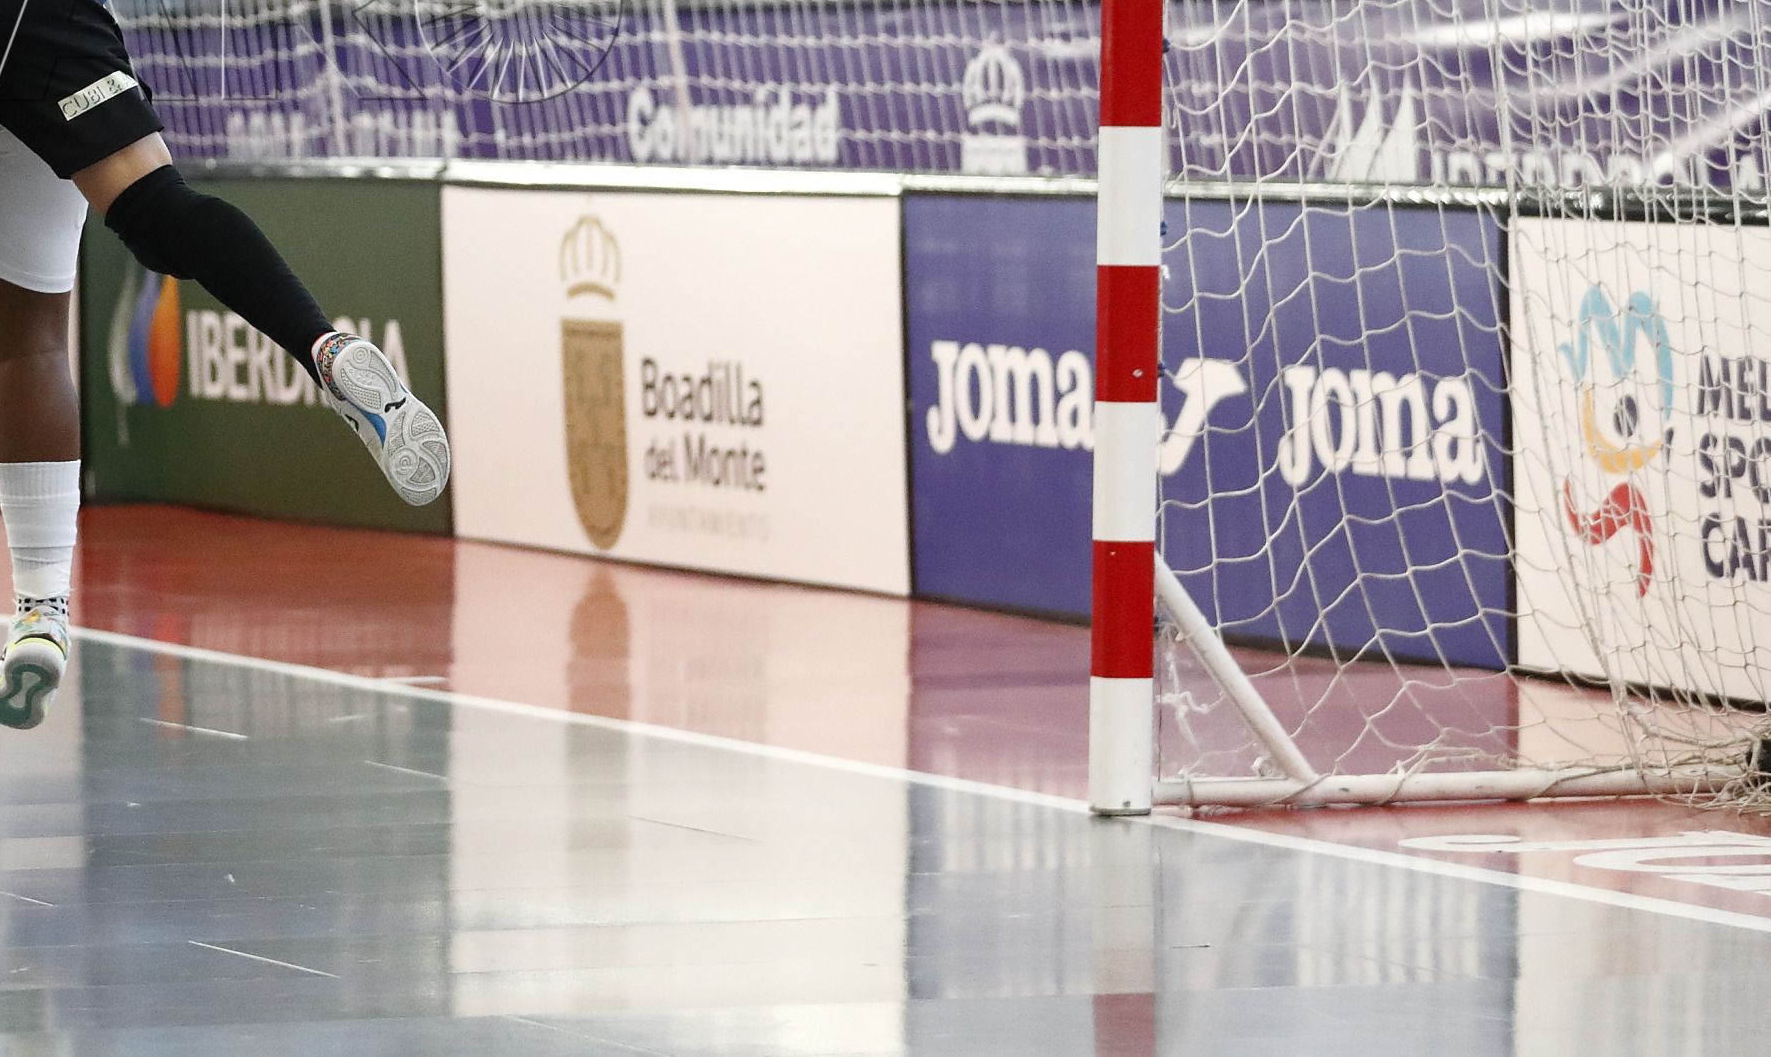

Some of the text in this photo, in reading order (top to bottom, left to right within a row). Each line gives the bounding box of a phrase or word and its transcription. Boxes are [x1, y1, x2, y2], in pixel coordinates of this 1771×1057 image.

[62, 85, 106, 117] CUBI
[628, 86, 841, 164] Comunidad
[641, 356, 764, 427] Boadilla
[644, 432, 767, 493] del Monte
